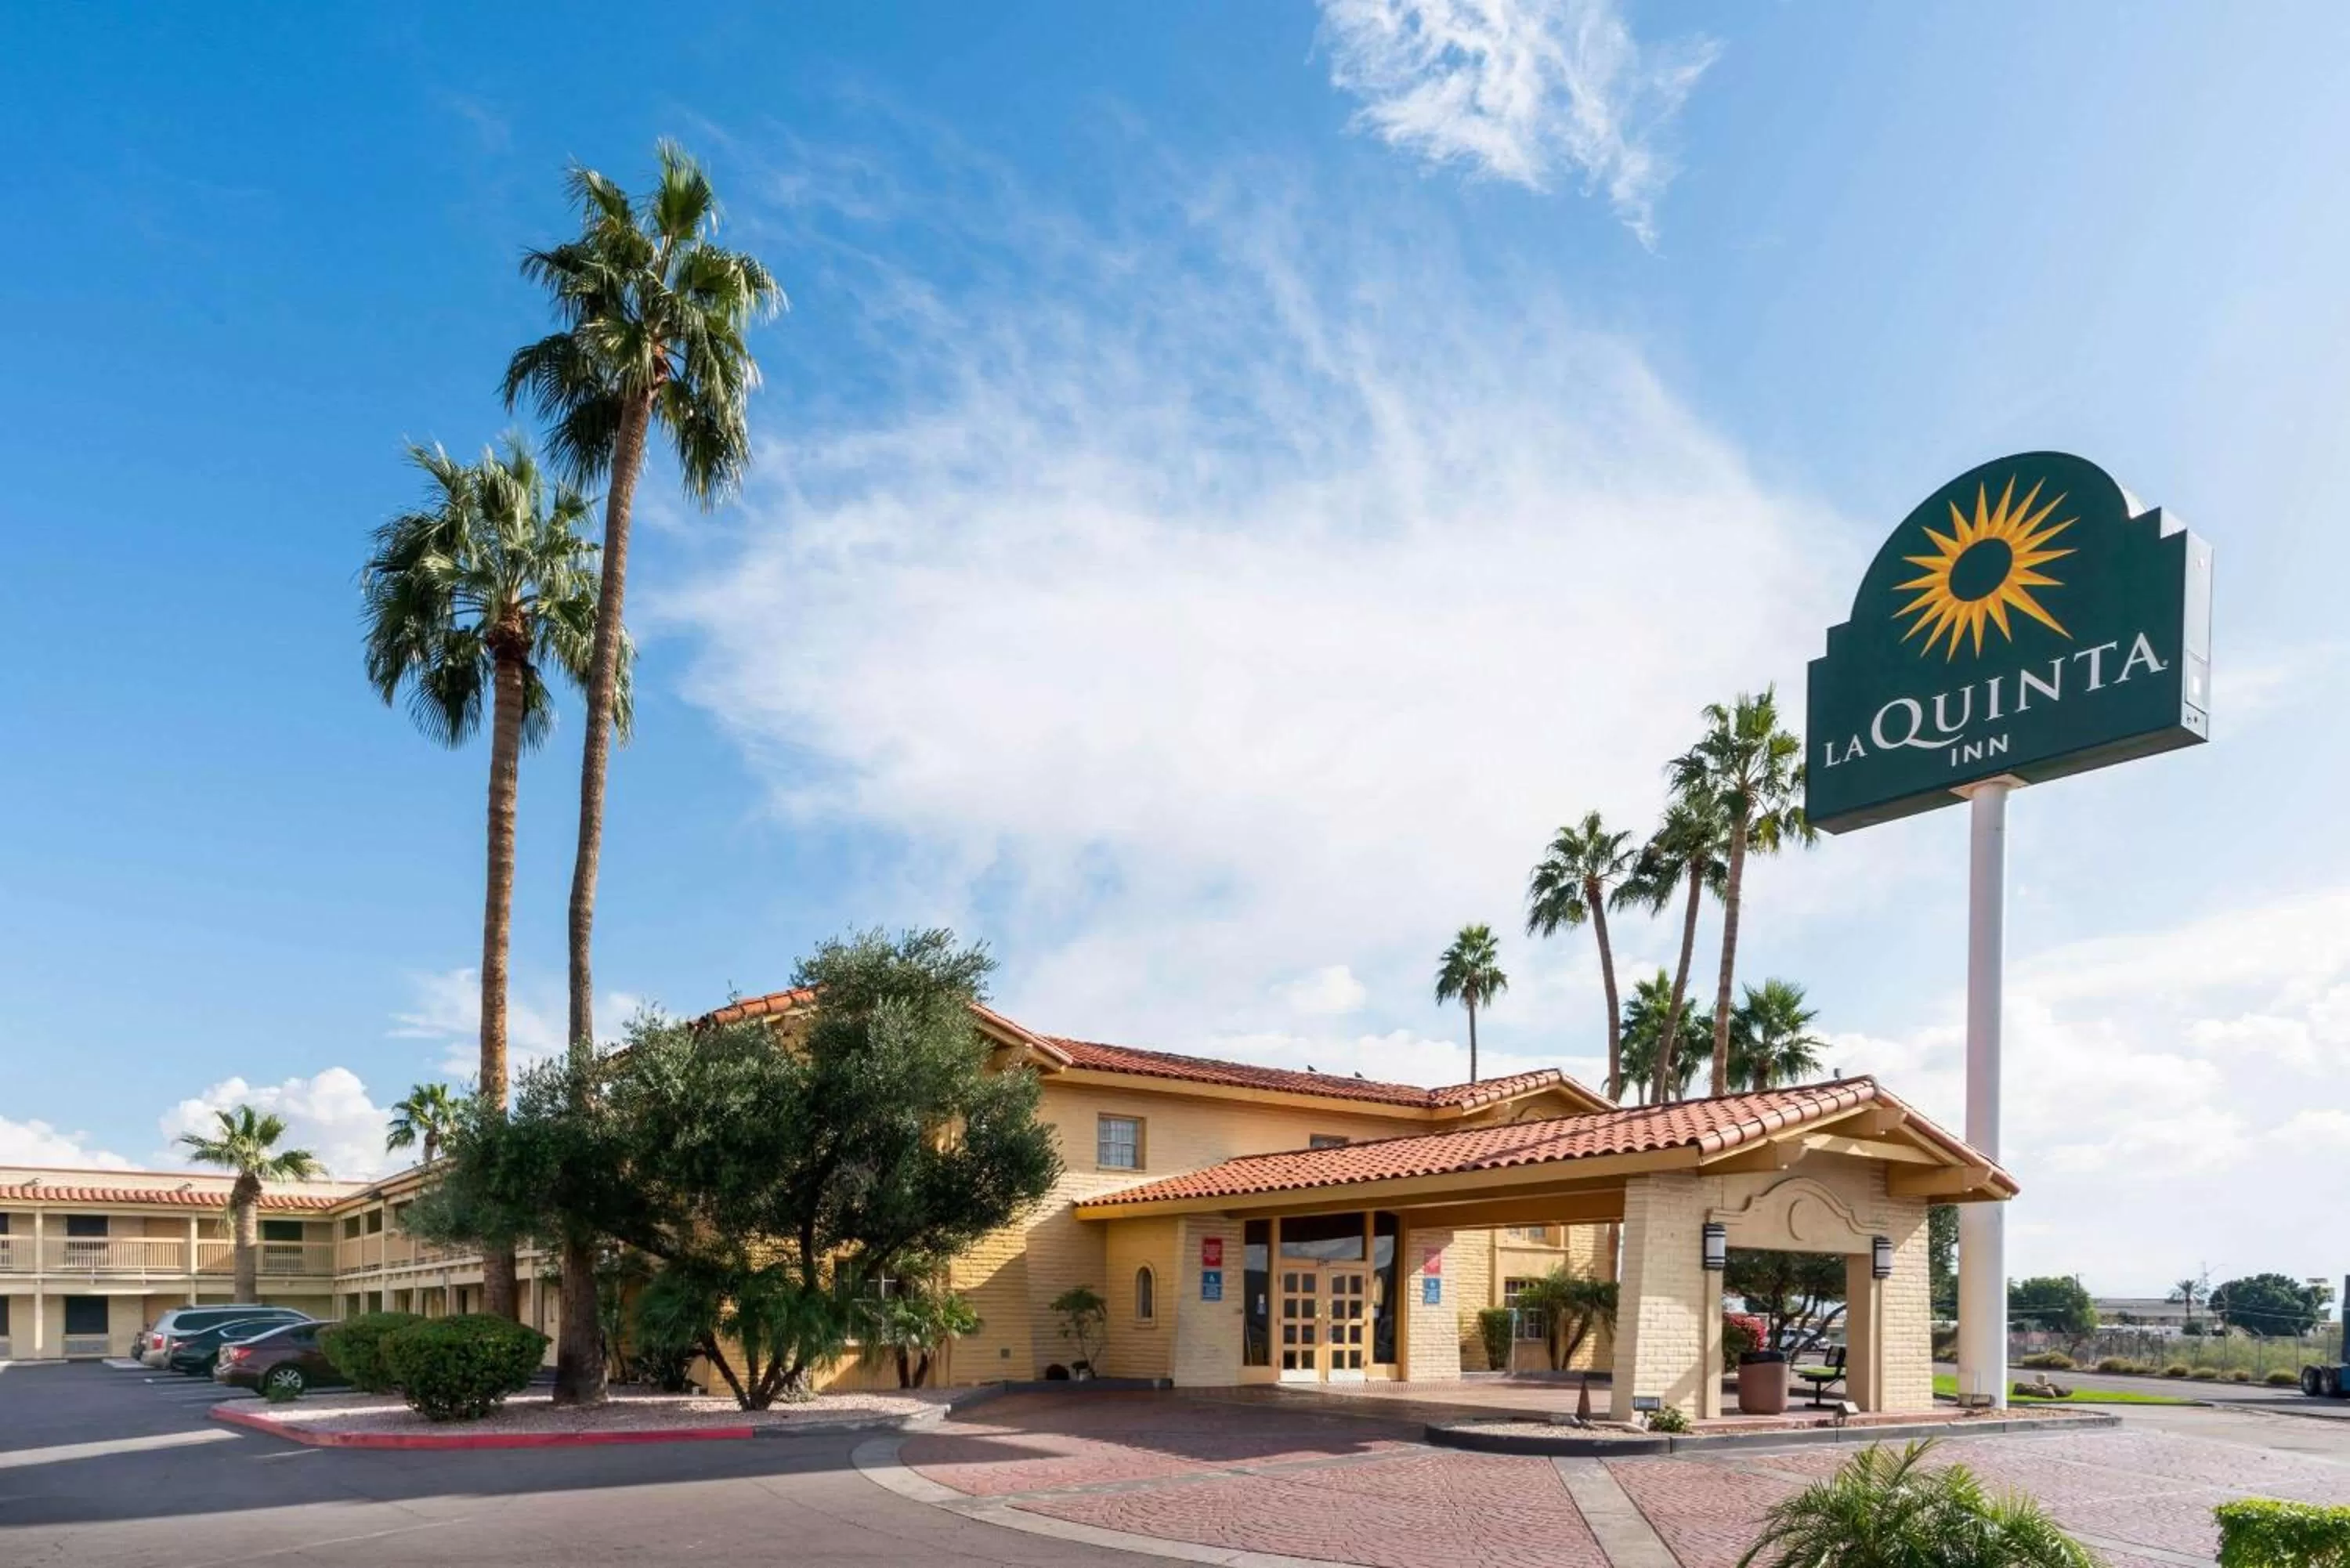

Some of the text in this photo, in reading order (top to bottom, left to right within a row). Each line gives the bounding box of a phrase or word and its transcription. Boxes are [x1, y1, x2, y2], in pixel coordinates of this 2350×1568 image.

[1824, 632, 2168, 768] LA QUINTA
[1951, 734, 2009, 768] INN
